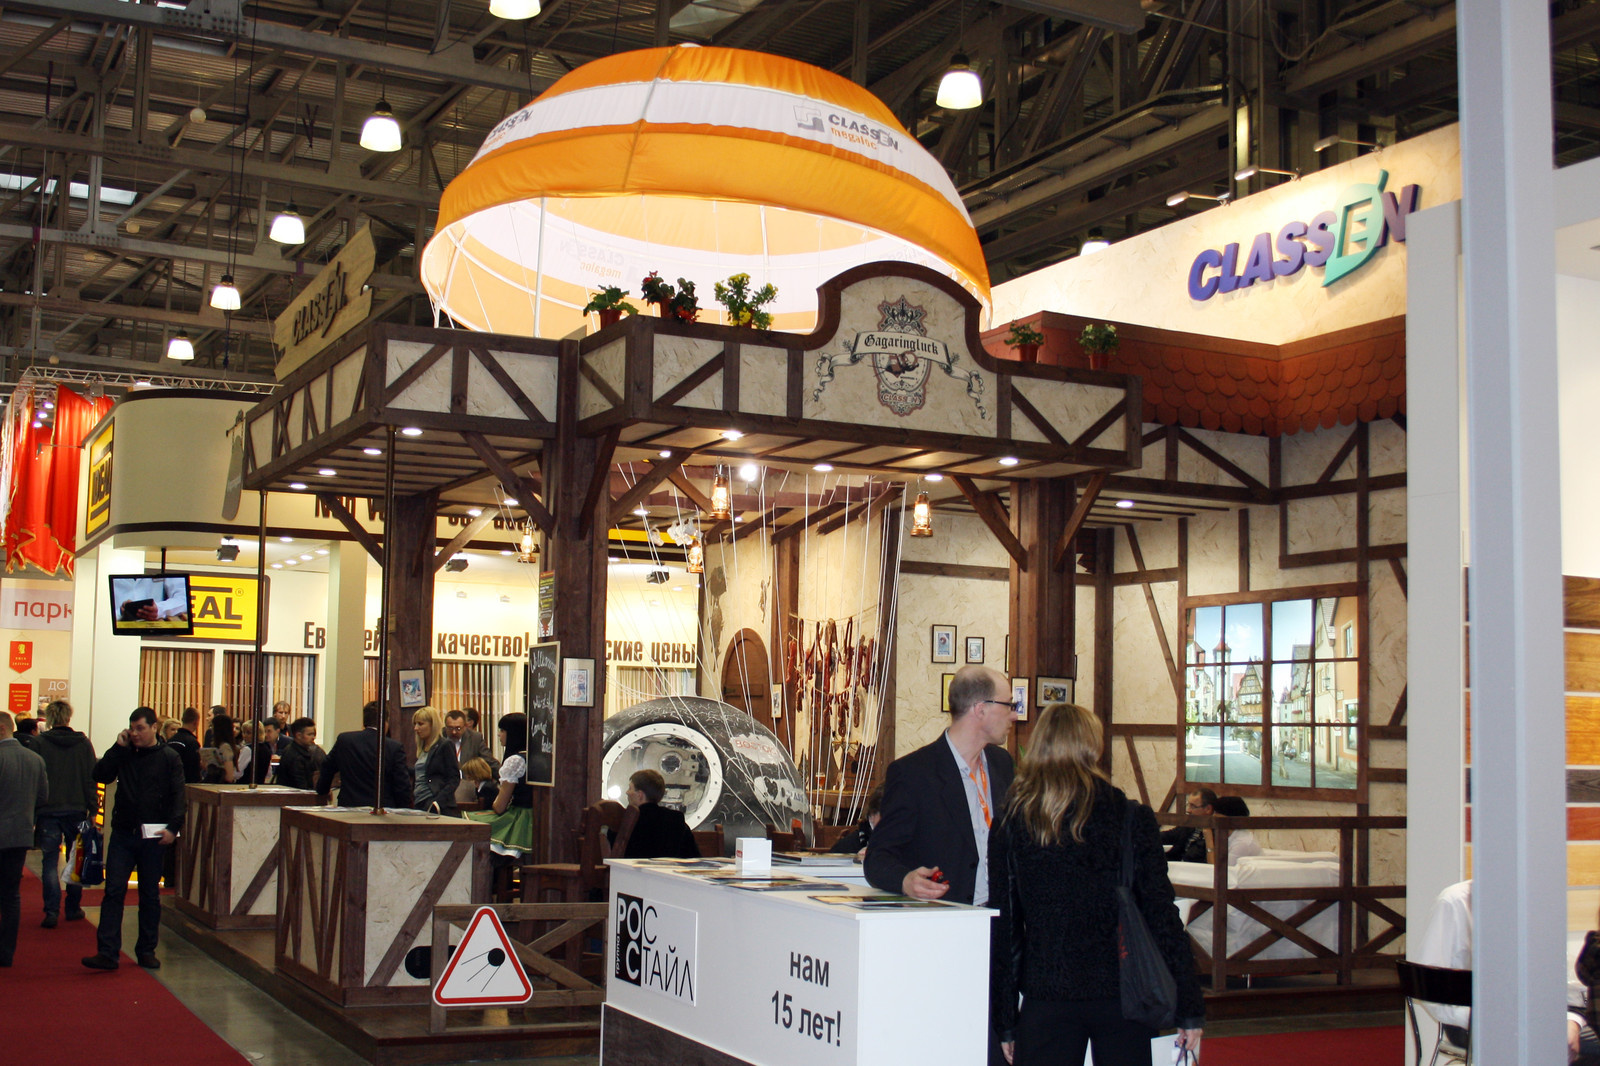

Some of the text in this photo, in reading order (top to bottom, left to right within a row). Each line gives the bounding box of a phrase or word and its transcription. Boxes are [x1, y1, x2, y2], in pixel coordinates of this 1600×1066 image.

[828, 113, 899, 151] CLASSEN
[831, 127, 878, 150] megaloc
[1188, 169, 1421, 301] CLASSEN
[292, 262, 347, 346] CLASSEN
[864, 334, 939, 355] Gagaringluck
[437, 632, 529, 657] качество!
[605, 640, 643, 661] ские
[790, 951, 829, 988] нам
[772, 990, 841, 1047] 15 лет!
